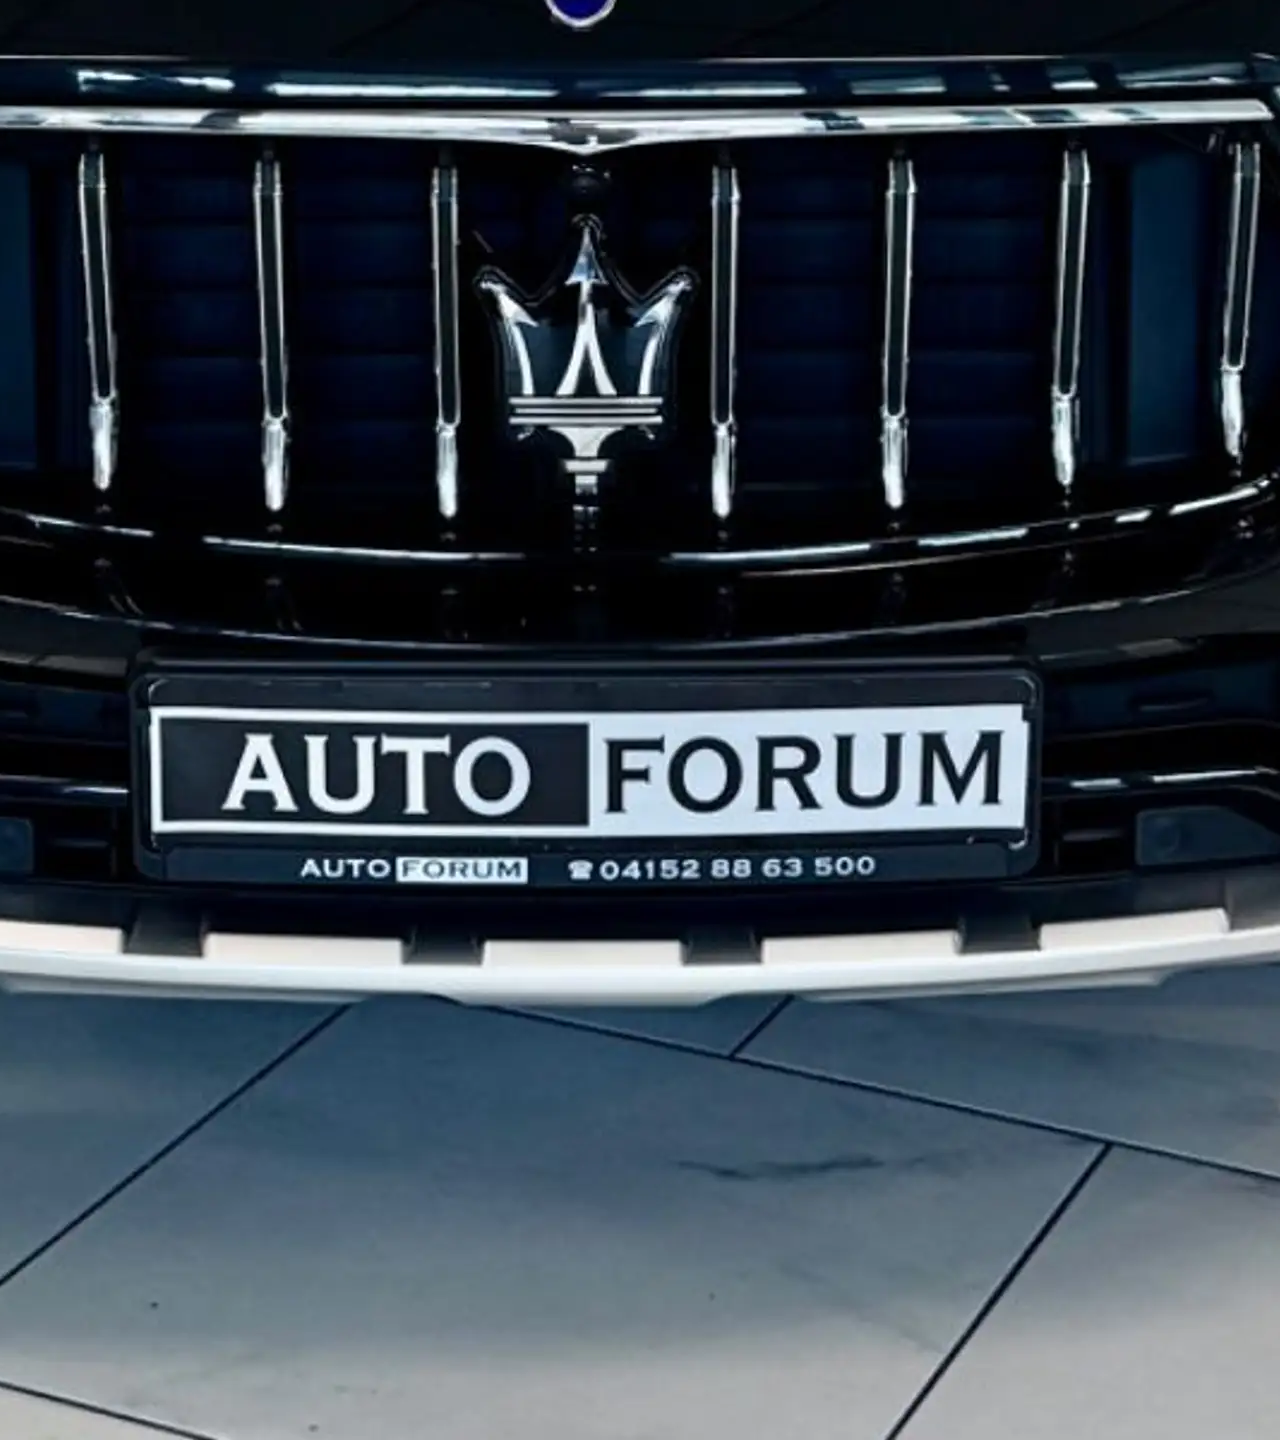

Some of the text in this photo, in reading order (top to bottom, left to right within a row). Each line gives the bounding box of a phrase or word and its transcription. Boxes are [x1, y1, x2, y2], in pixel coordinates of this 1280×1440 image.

[221, 730, 1004, 817] AUTO FORUM
[300, 856, 875, 880] AUTO FORUM 04152 88 63 500
